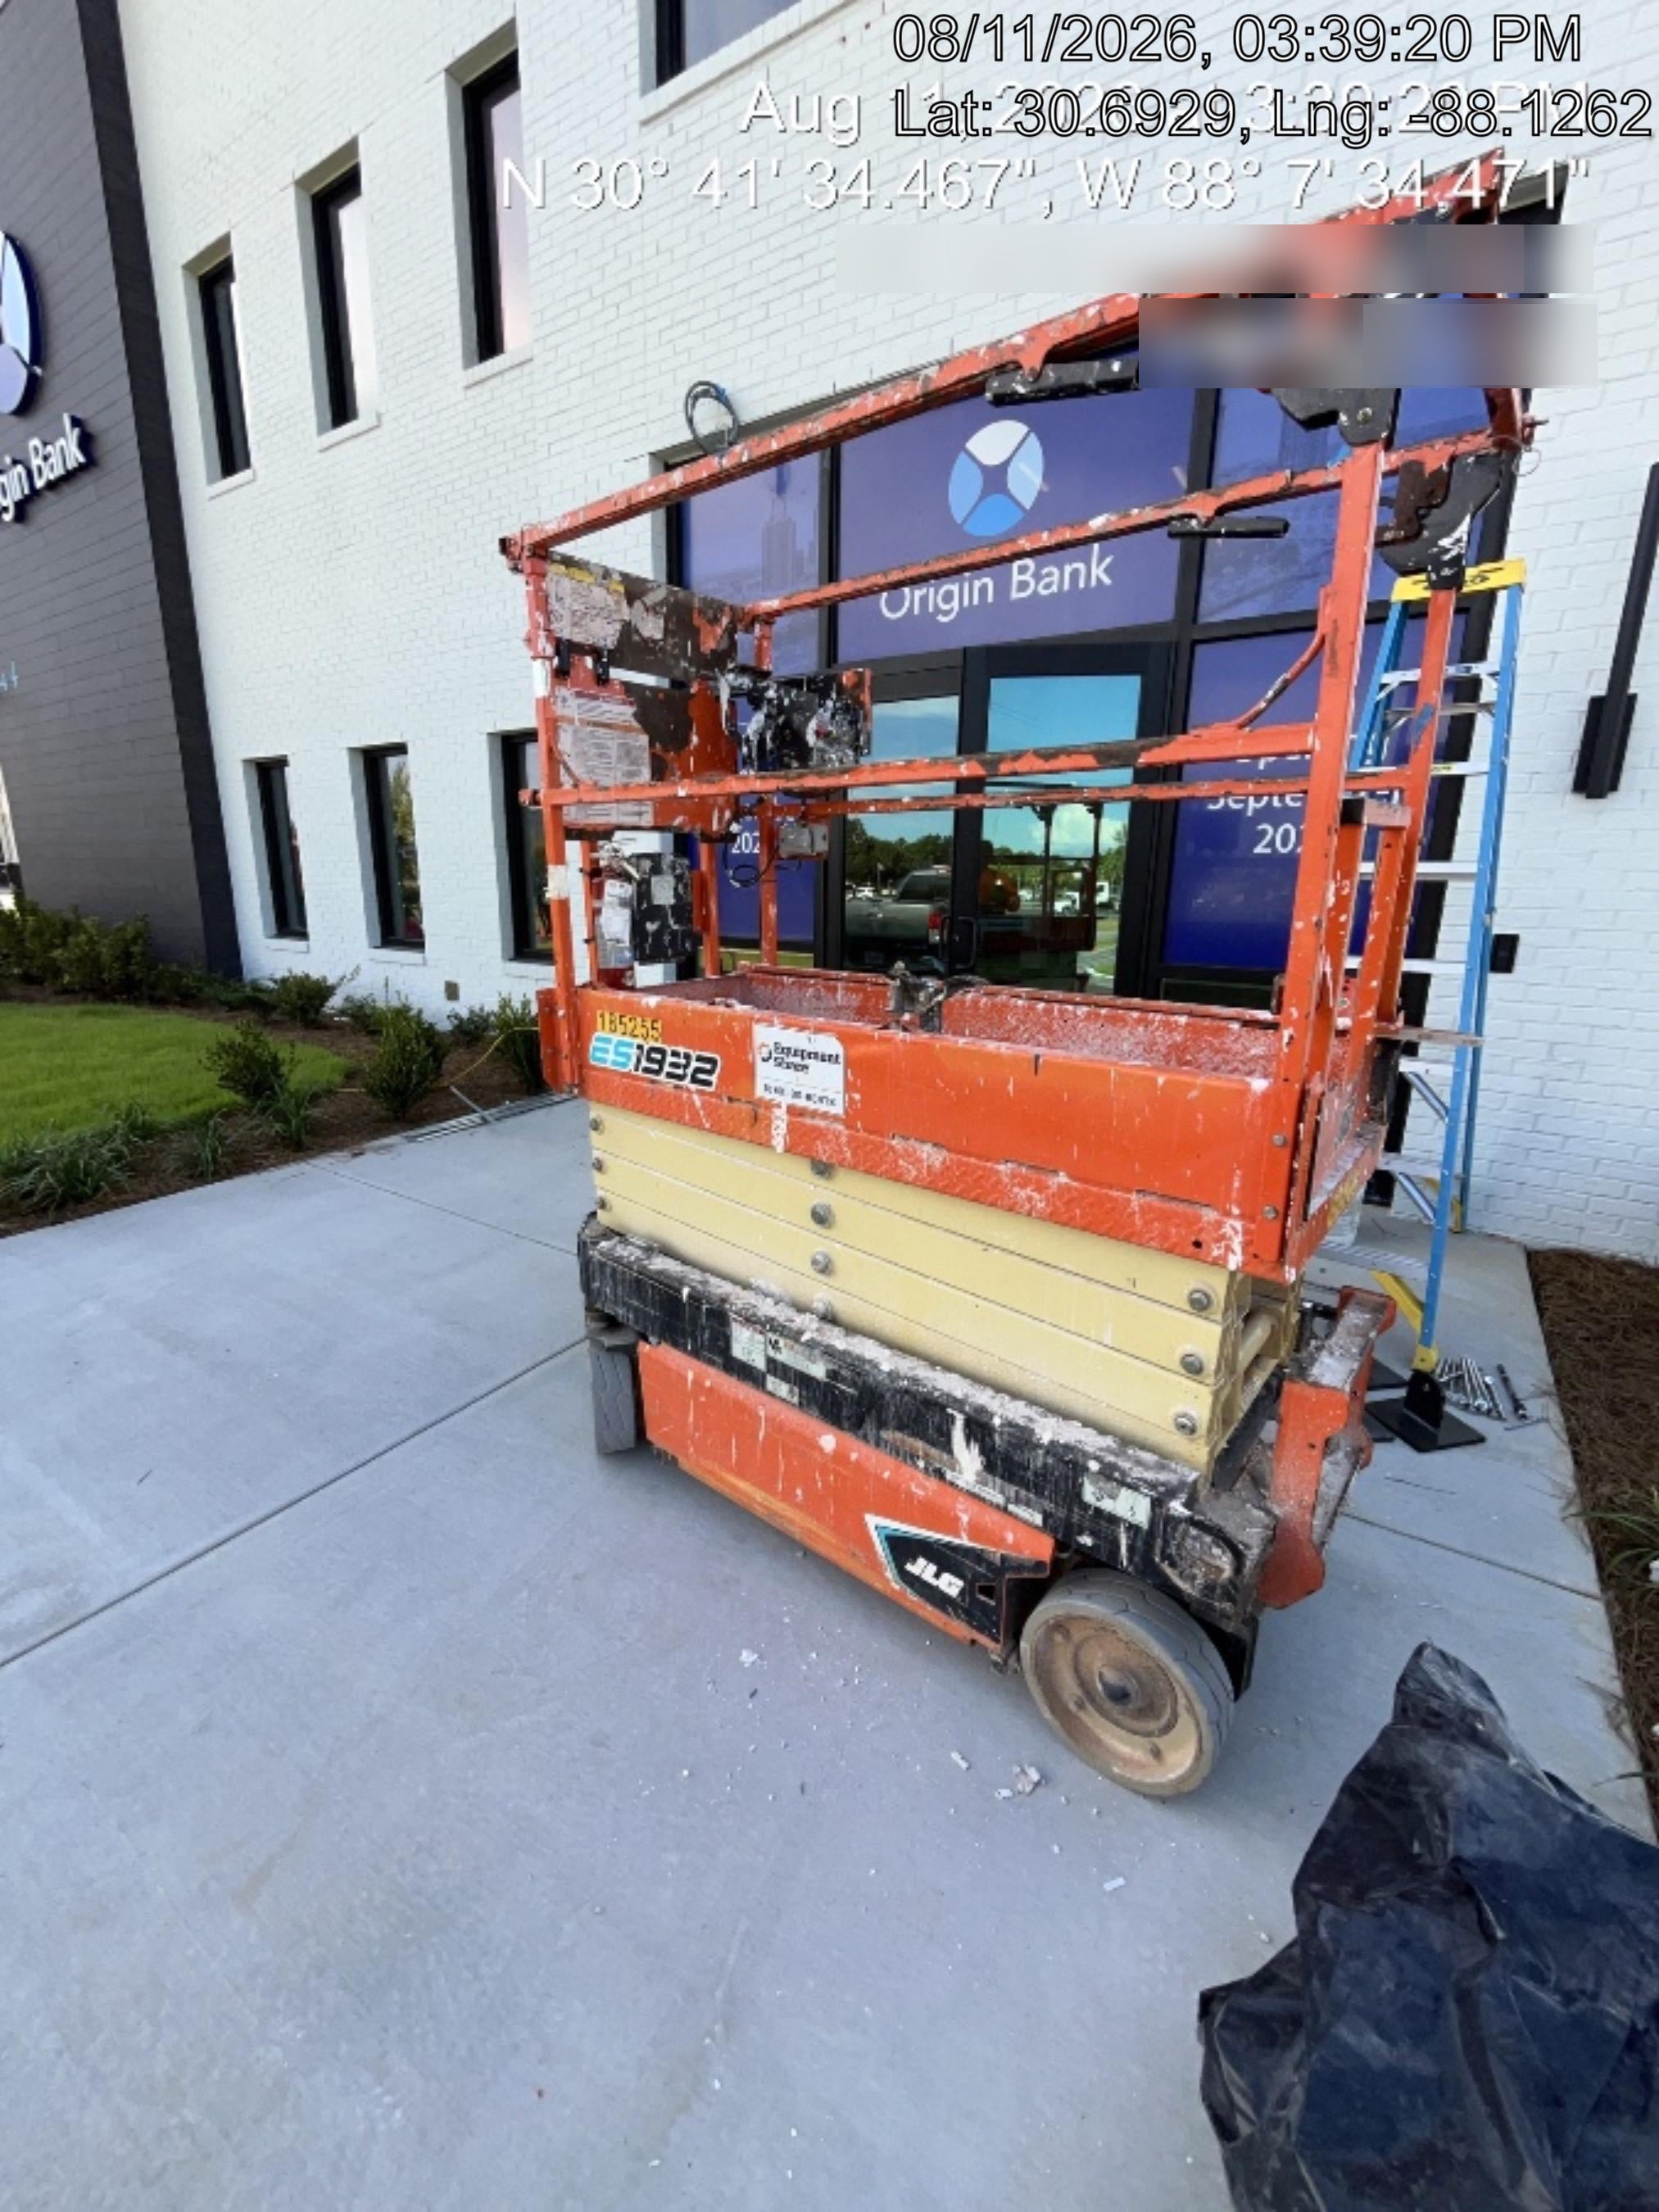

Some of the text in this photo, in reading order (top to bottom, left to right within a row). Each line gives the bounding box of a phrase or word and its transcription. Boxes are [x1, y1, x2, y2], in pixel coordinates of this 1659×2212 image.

[29, 412, 87, 490] Bank
[879, 542, 1115, 623] Origin Bank
[590, 1034, 719, 1088] ES1932
[903, 1555, 965, 1598] JLG
